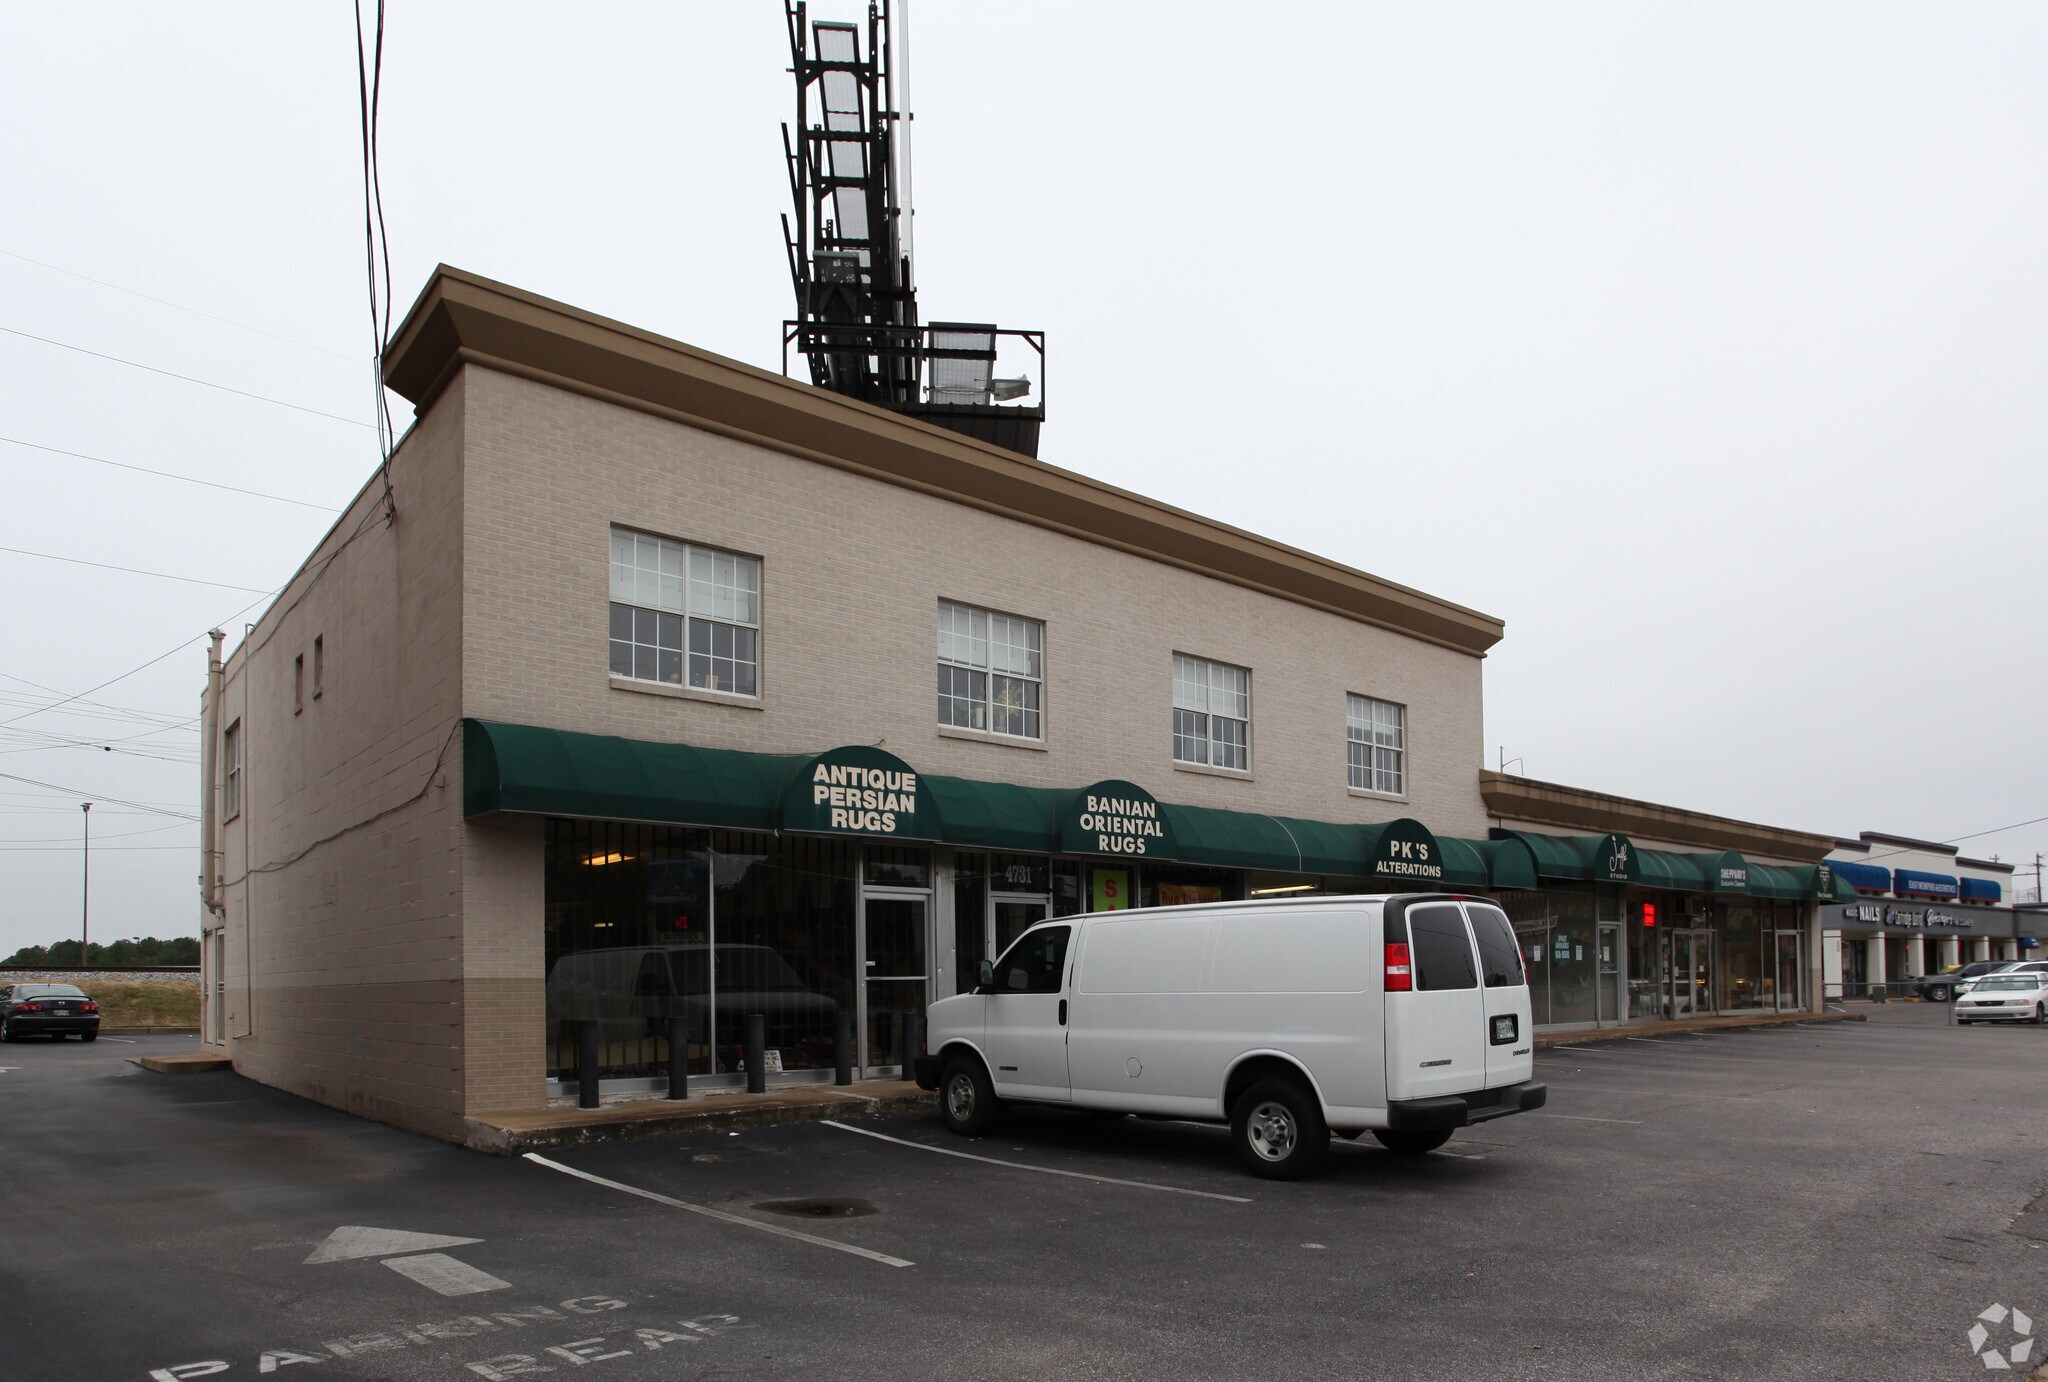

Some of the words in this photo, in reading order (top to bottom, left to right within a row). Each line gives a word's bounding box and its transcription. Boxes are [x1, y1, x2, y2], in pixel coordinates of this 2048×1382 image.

[813, 763, 916, 793] ANTIQUE
[814, 785, 915, 813] PERSIAN
[1087, 795, 1156, 819] BANIAN
[831, 808, 896, 833] RUGS
[1079, 813, 1163, 838] ORIENTAL
[1098, 834, 1146, 854] RUGS
[1390, 840, 1429, 861] PK'S
[1004, 864, 1032, 885] 4731
[1376, 861, 1441, 878] ALTERATIONS
[1720, 868, 1746, 880] SHEPPARD'S
[1860, 905, 1880, 921] NAILS
